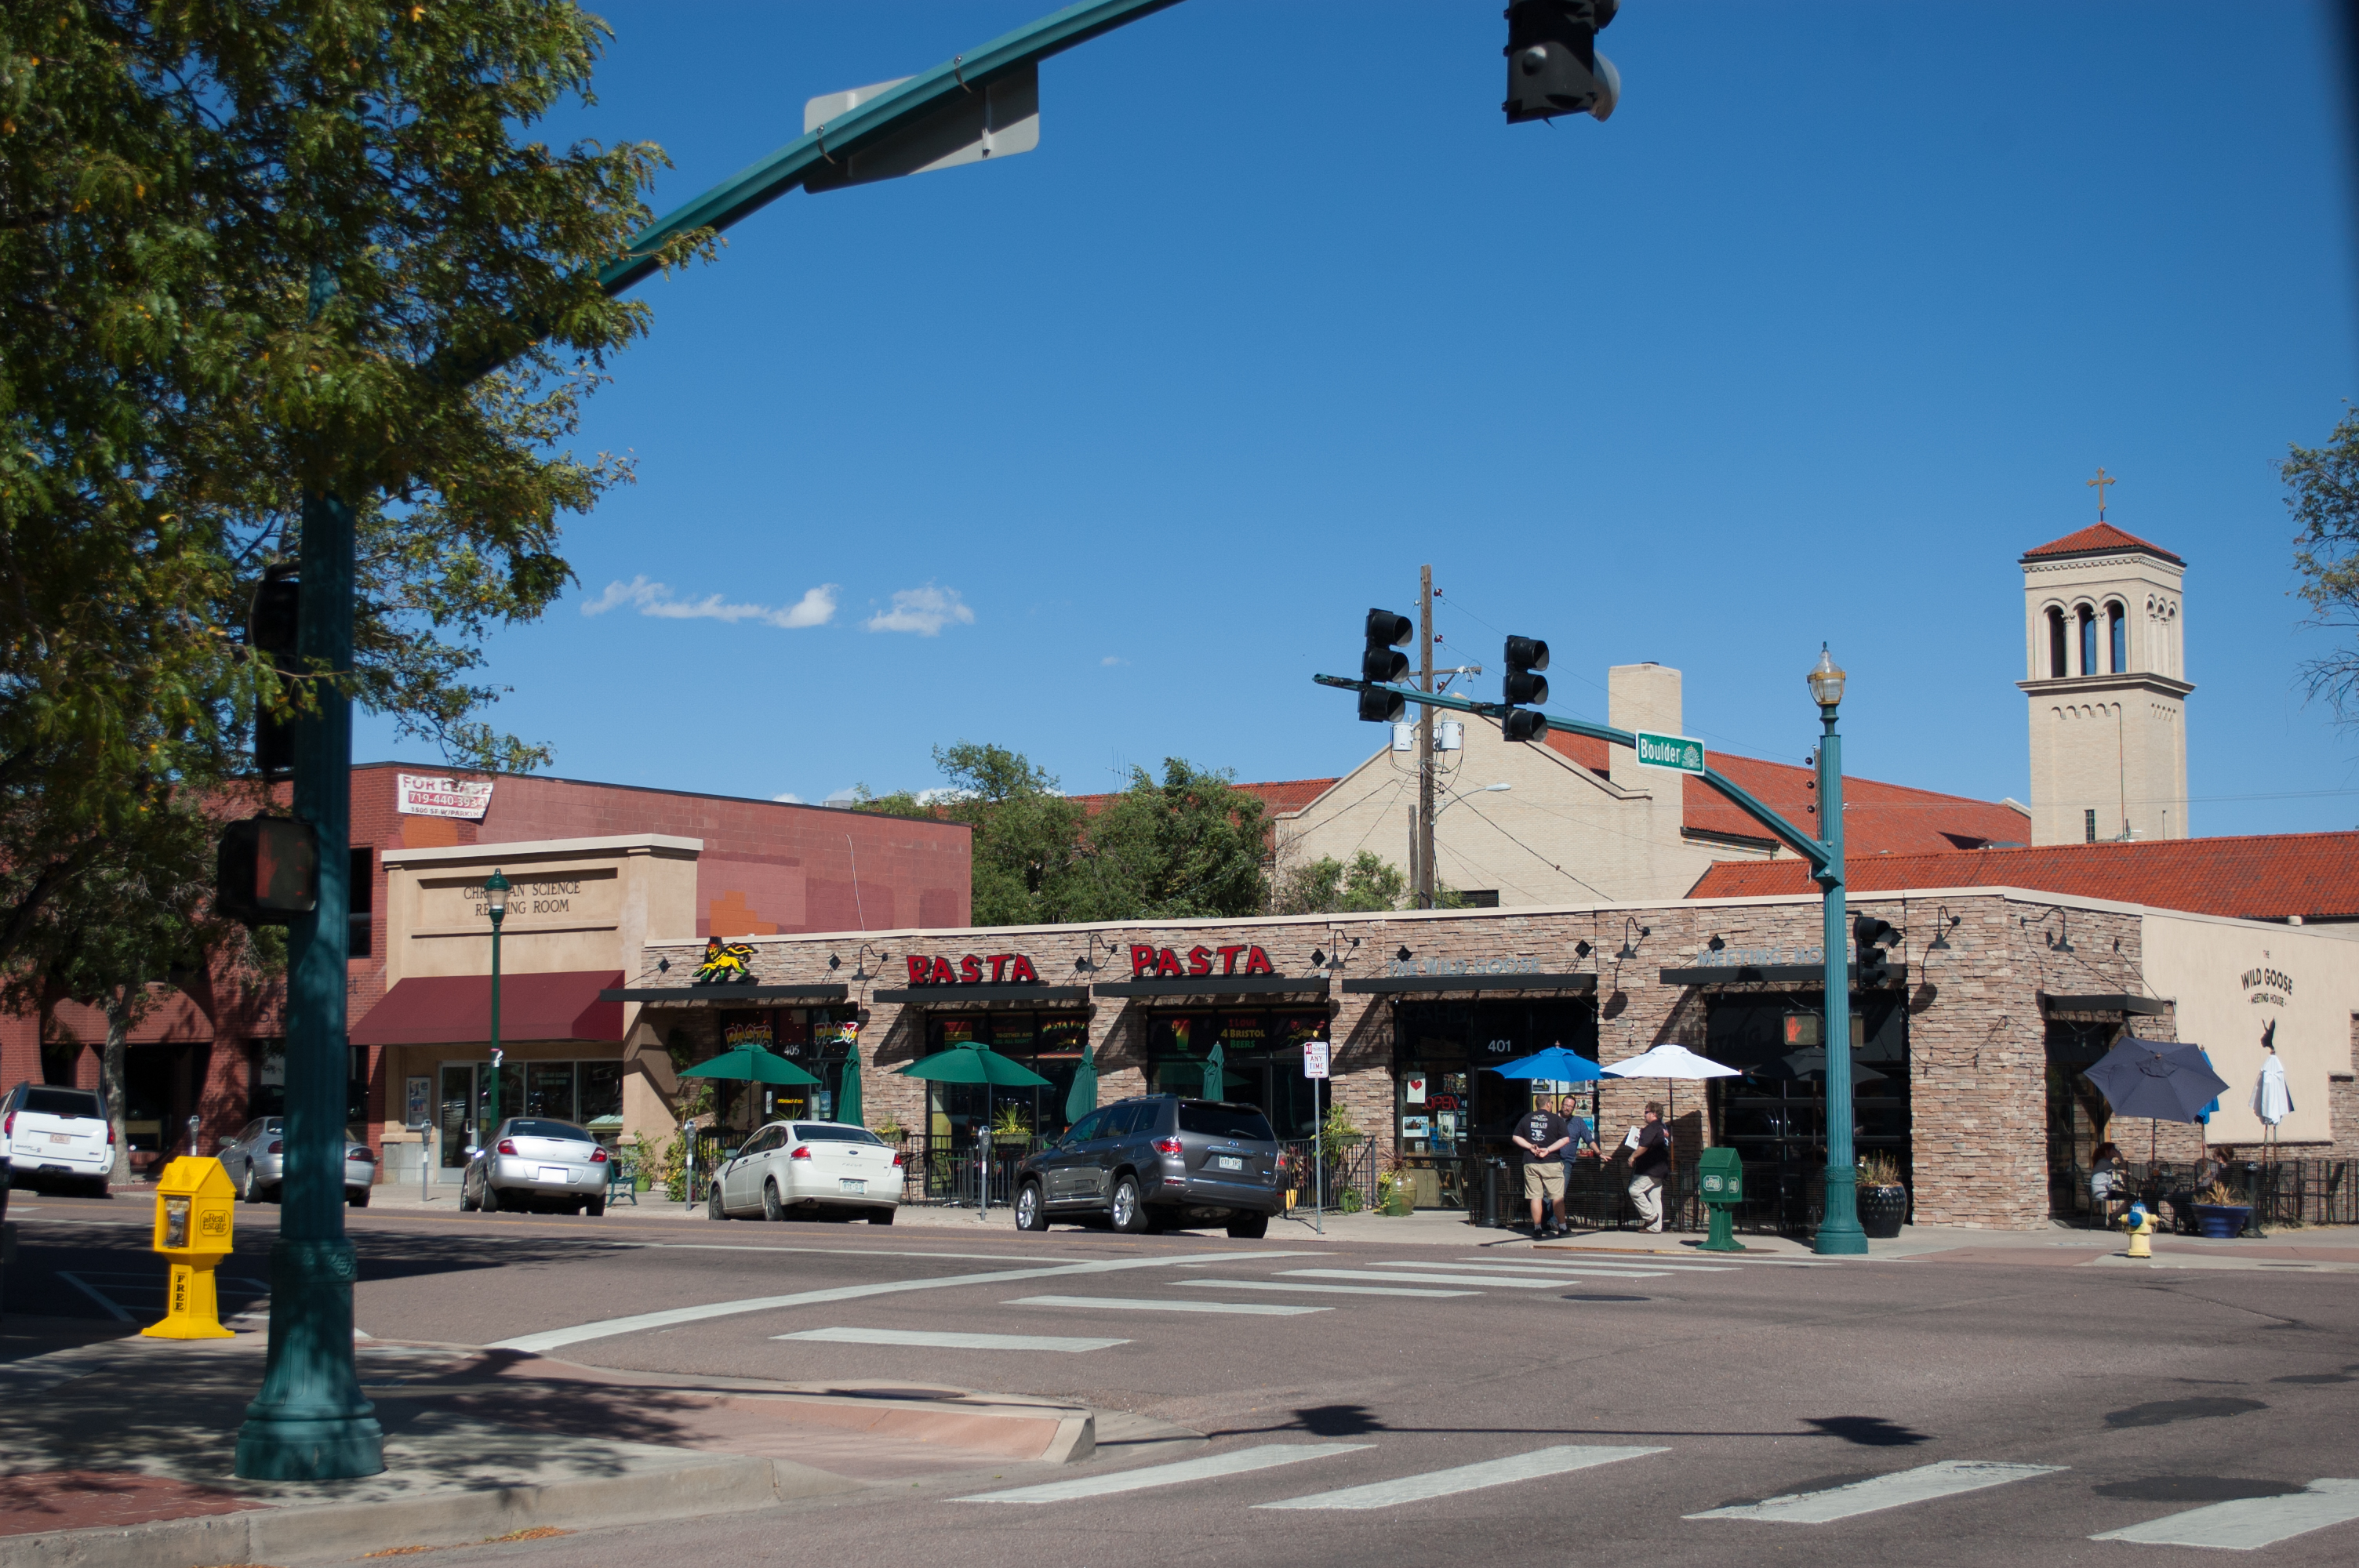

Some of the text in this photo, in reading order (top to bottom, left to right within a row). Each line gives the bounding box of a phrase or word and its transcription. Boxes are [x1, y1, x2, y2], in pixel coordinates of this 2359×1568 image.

[1641, 739, 1680, 763] Boulder
[403, 776, 435, 790] FOR
[409, 792, 486, 808] 719-440-3934
[463, 881, 580, 899] CHRAN SCIENCE
[475, 899, 569, 916] REING ROOM
[1129, 944, 1275, 977] PASTA
[1697, 948, 1782, 966] MEETING
[906, 953, 1039, 984] RASTA
[1387, 957, 1540, 976] THE WILD GOOSE
[2241, 967, 2292, 996] WILD GOOSE
[2251, 993, 2269, 1004] MEETING
[1230, 1029, 1265, 1038] BRISTOL
[784, 1044, 800, 1055] 405
[1230, 1040, 1255, 1048] BEERS
[1488, 1040, 1510, 1052] 401
[1425, 1096, 1459, 1110] OPEN
[202, 1221, 227, 1230] Estate
[209, 1213, 226, 1222] Real
[175, 1275, 185, 1311] FREE
